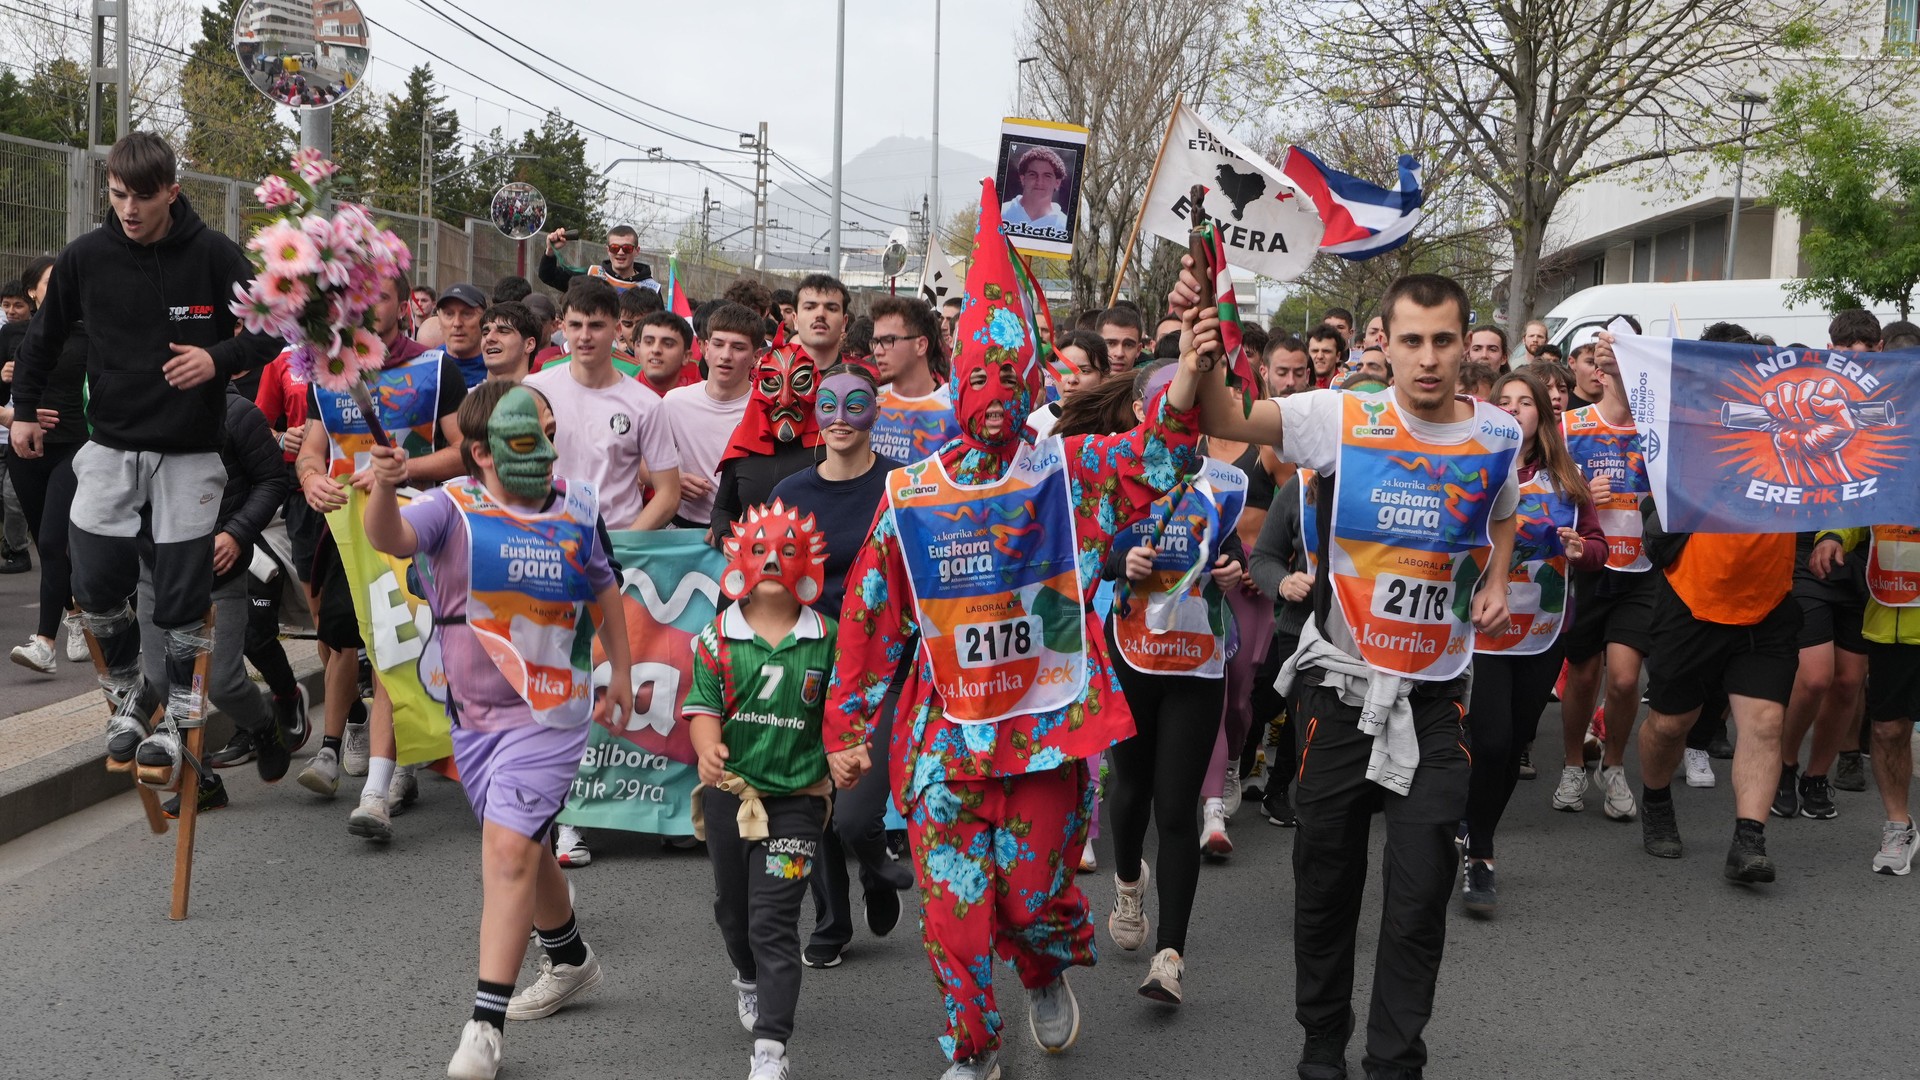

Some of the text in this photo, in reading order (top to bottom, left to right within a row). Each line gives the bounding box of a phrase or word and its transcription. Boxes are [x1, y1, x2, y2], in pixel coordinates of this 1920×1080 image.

[1171, 195, 1289, 254] EXERA
[1755, 350, 1880, 393] NO AL ERE
[1630, 388, 1639, 421] UBOS
[1637, 372, 1648, 423] REUNIDOS
[1646, 389, 1656, 424] GROUP
[1494, 429, 1520, 441] eitb
[1031, 453, 1059, 473] eitb
[1219, 472, 1243, 486] eitb
[1381, 478, 1426, 491] 24.korrika
[1841, 477, 1878, 501] EZ
[1370, 488, 1441, 509] Euskara
[1376, 506, 1441, 530] gara
[932, 529, 973, 542] 24.korrika
[500, 543, 561, 562] Euskara
[927, 540, 990, 560] Euskara
[508, 559, 562, 583] gara
[938, 554, 993, 583] gara
[1397, 556, 1439, 570] LABORAL
[252, 598, 271, 607] VANS
[966, 602, 1007, 614] LABORAL
[1383, 579, 1448, 622] 2178
[1531, 617, 1556, 635] aek
[966, 620, 1031, 662] 2178
[1124, 635, 1202, 658] 24.korrika
[1447, 636, 1467, 655] aek
[757, 664, 784, 700] 7
[938, 670, 1023, 699] 24.korrika
[1036, 659, 1075, 686] aek
[580, 743, 669, 771] Bilbora
[612, 778, 665, 802] 29ra
